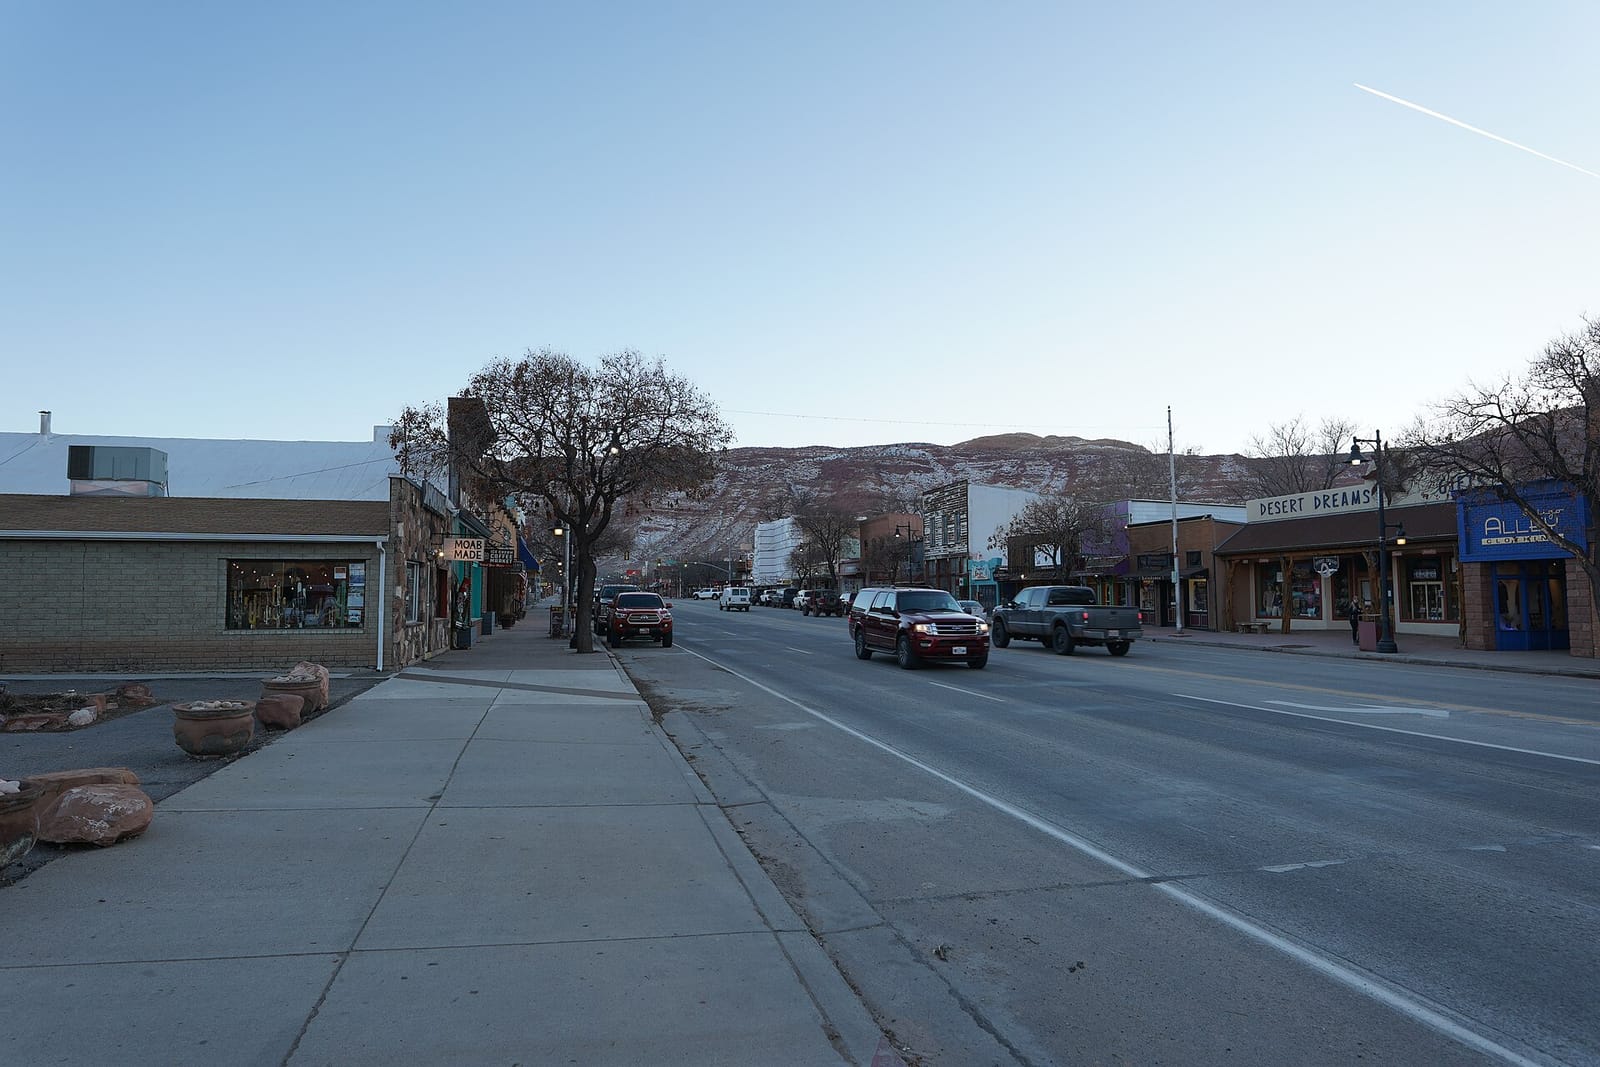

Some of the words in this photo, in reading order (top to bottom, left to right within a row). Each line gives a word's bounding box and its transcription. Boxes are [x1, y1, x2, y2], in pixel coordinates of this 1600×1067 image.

[1260, 498, 1304, 516] DESERT
[1313, 489, 1370, 510] DREAMS
[1484, 517, 1559, 535] ALLEY
[454, 540, 482, 549] MOAB
[454, 550, 482, 560] MADE
